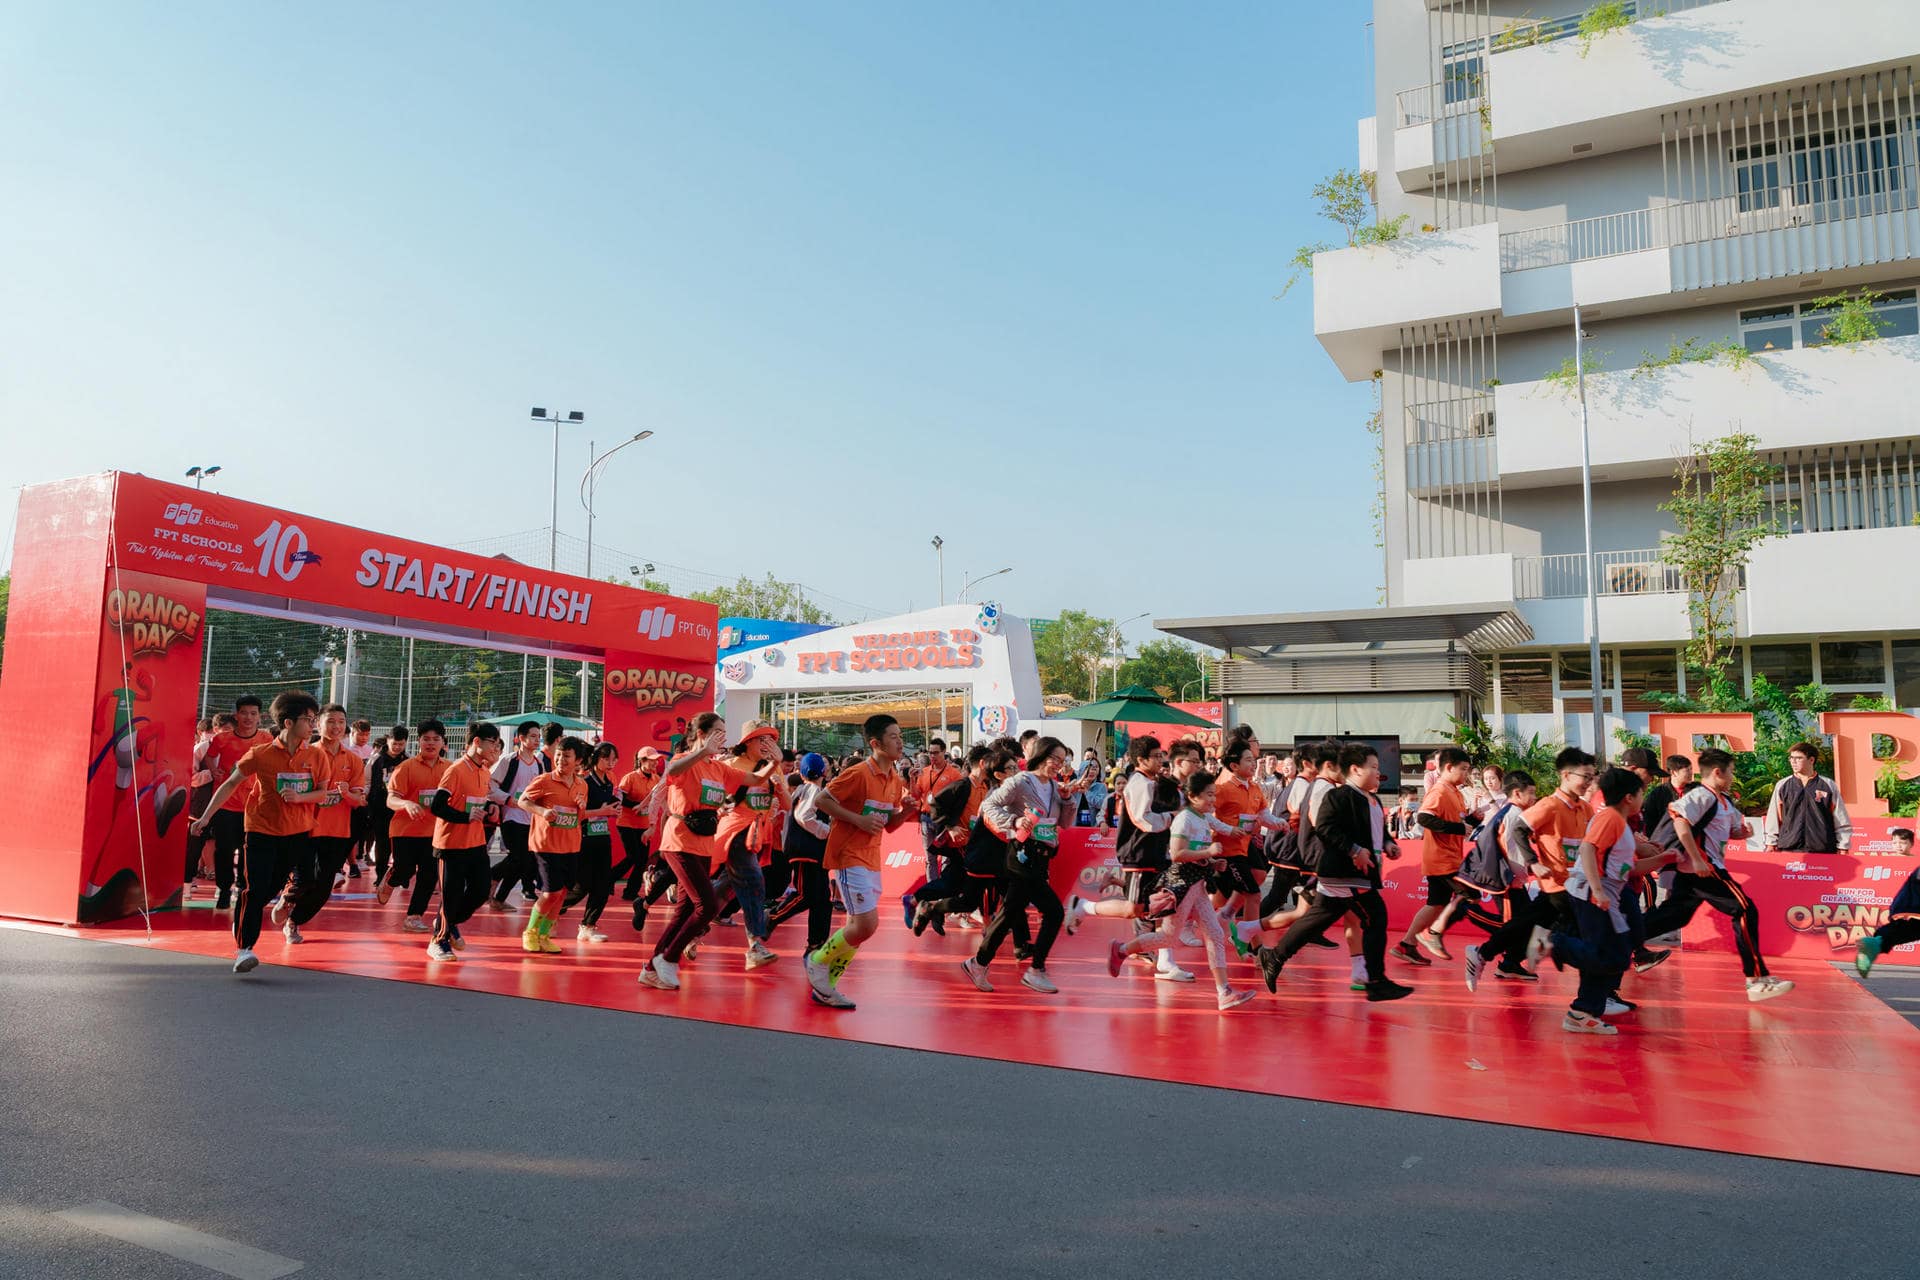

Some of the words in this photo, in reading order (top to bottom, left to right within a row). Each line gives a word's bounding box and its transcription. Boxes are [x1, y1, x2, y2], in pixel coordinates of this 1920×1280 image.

[164, 503, 203, 525] FPT
[204, 516, 239, 530] Education
[154, 528, 179, 542] FPT
[181, 533, 243, 554] SCHOOLS
[253, 520, 308, 581] 10
[355, 548, 592, 625] START/FINISH
[106, 588, 201, 637] ORANGE
[133, 621, 176, 652] DAY
[678, 621, 695, 635] FPT
[695, 624, 712, 640] City
[852, 630, 940, 649] WELCOME
[949, 629, 974, 643] TO
[797, 650, 843, 673] FPT
[850, 645, 975, 671] SCHOOLS
[606, 668, 708, 695] ORANGE
[636, 688, 682, 708] DAY
